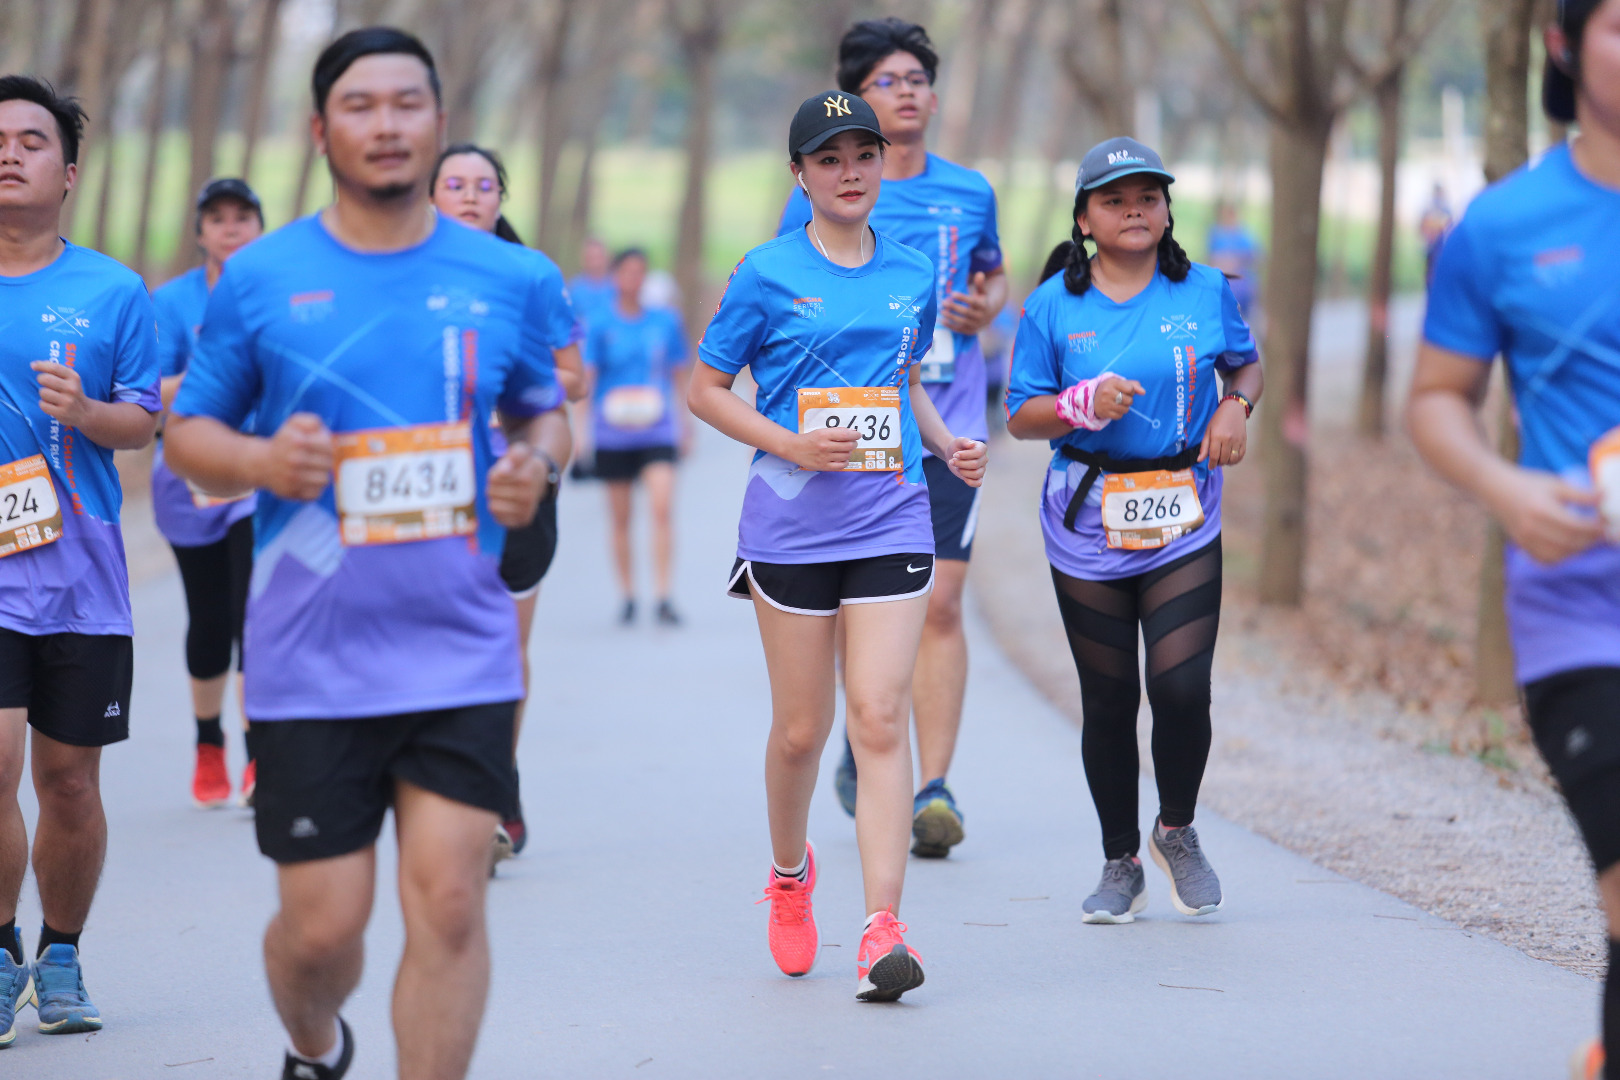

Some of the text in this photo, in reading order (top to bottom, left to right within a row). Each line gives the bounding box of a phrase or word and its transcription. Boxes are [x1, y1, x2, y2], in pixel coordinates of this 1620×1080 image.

[823, 94, 852, 118] NY
[41, 313, 57, 323] SP
[888, 302, 901, 310] SP
[75, 317, 90, 328] XC
[1187, 321, 1198, 331] XC
[896, 326, 910, 365] CROSS
[1173, 346, 1184, 383] CROSS
[1185, 345, 1197, 392] SINGHA
[365, 457, 458, 502] 8434
[1124, 494, 1180, 522] 8266
